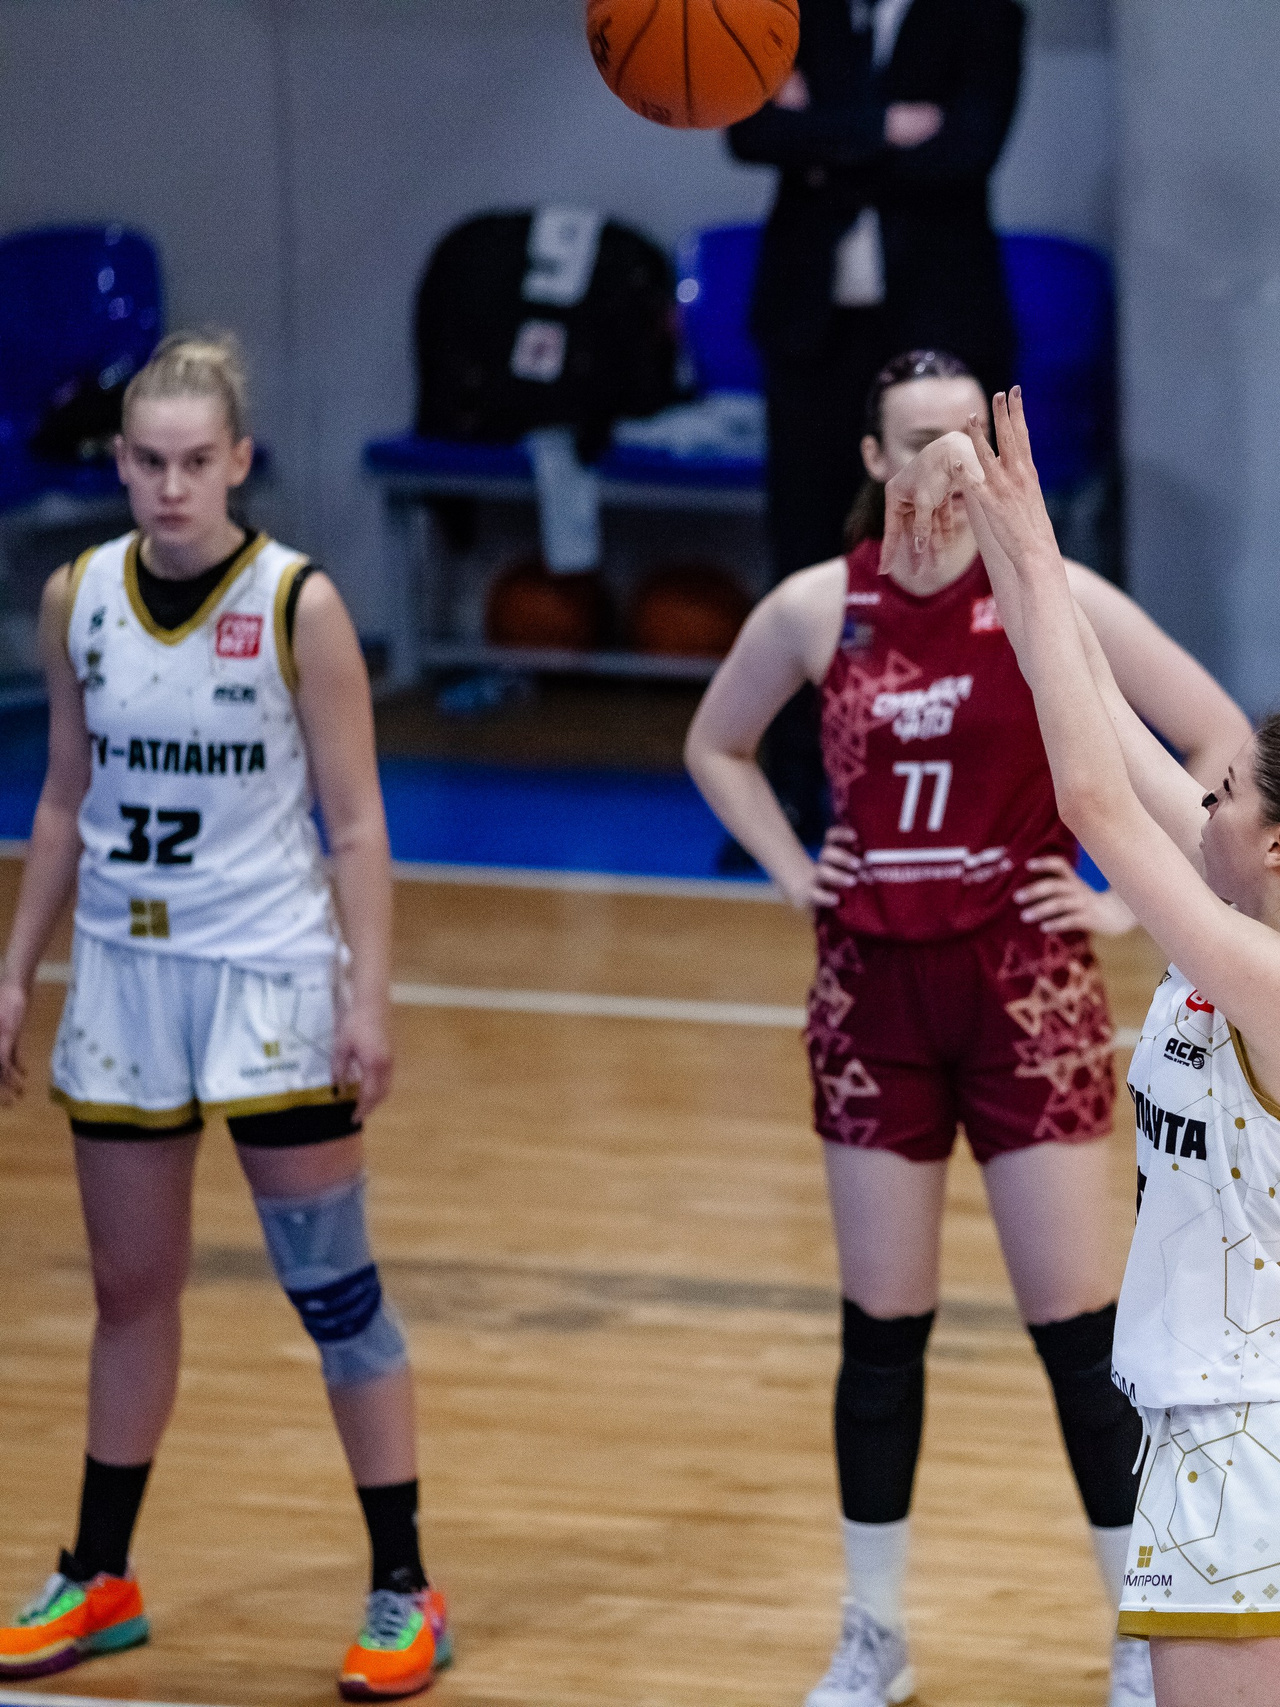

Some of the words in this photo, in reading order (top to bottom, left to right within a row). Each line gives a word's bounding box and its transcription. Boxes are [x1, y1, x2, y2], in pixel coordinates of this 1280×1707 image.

[892, 761, 953, 833] 77
[108, 805, 202, 866] 32
[1165, 1037, 1206, 1069] АСБ
